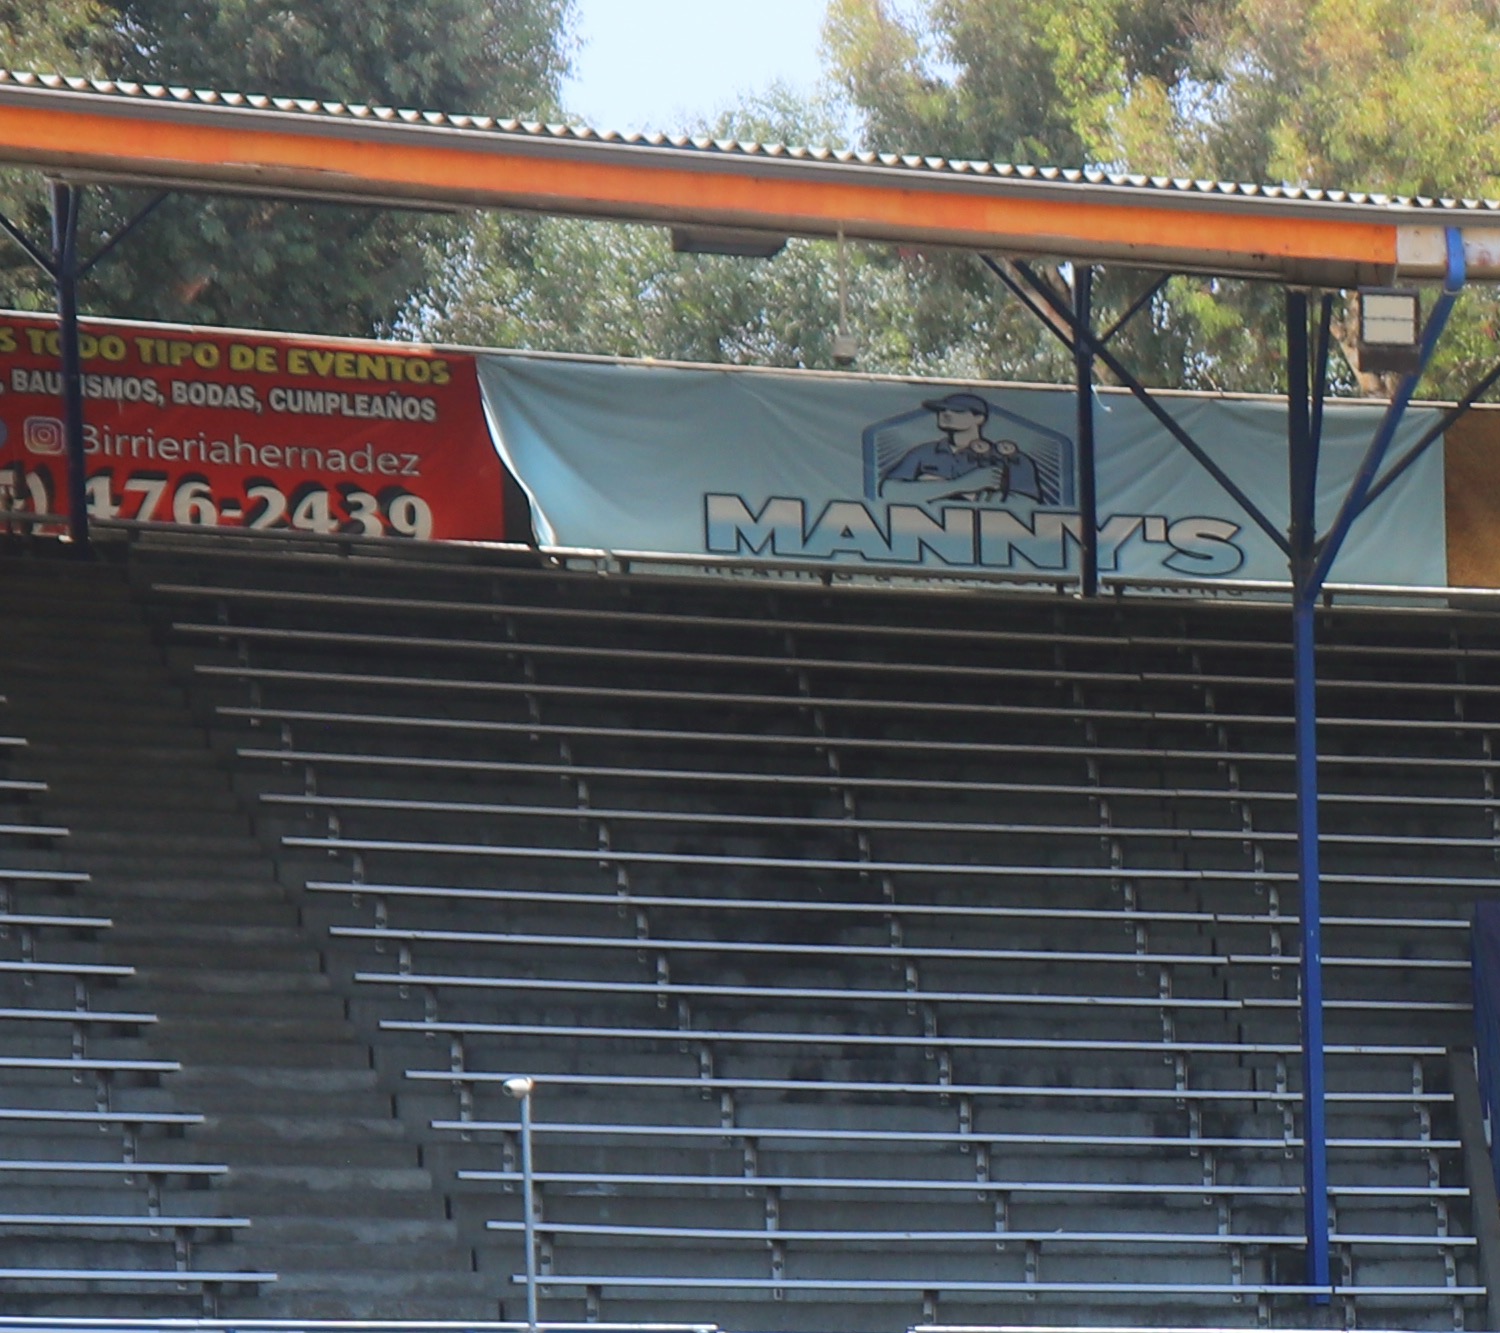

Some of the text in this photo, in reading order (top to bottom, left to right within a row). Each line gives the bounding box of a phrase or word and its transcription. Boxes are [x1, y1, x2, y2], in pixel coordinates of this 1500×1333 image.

[25, 328, 126, 361] TODO
[134, 337, 220, 368] TIPO
[229, 344, 278, 373] DE
[287, 348, 450, 385] EVENTOS
[11, 368, 437, 422] BAUISMOS, BODAS, CUMPLEAÑOS
[704, 493, 1244, 577] MANNY'S
